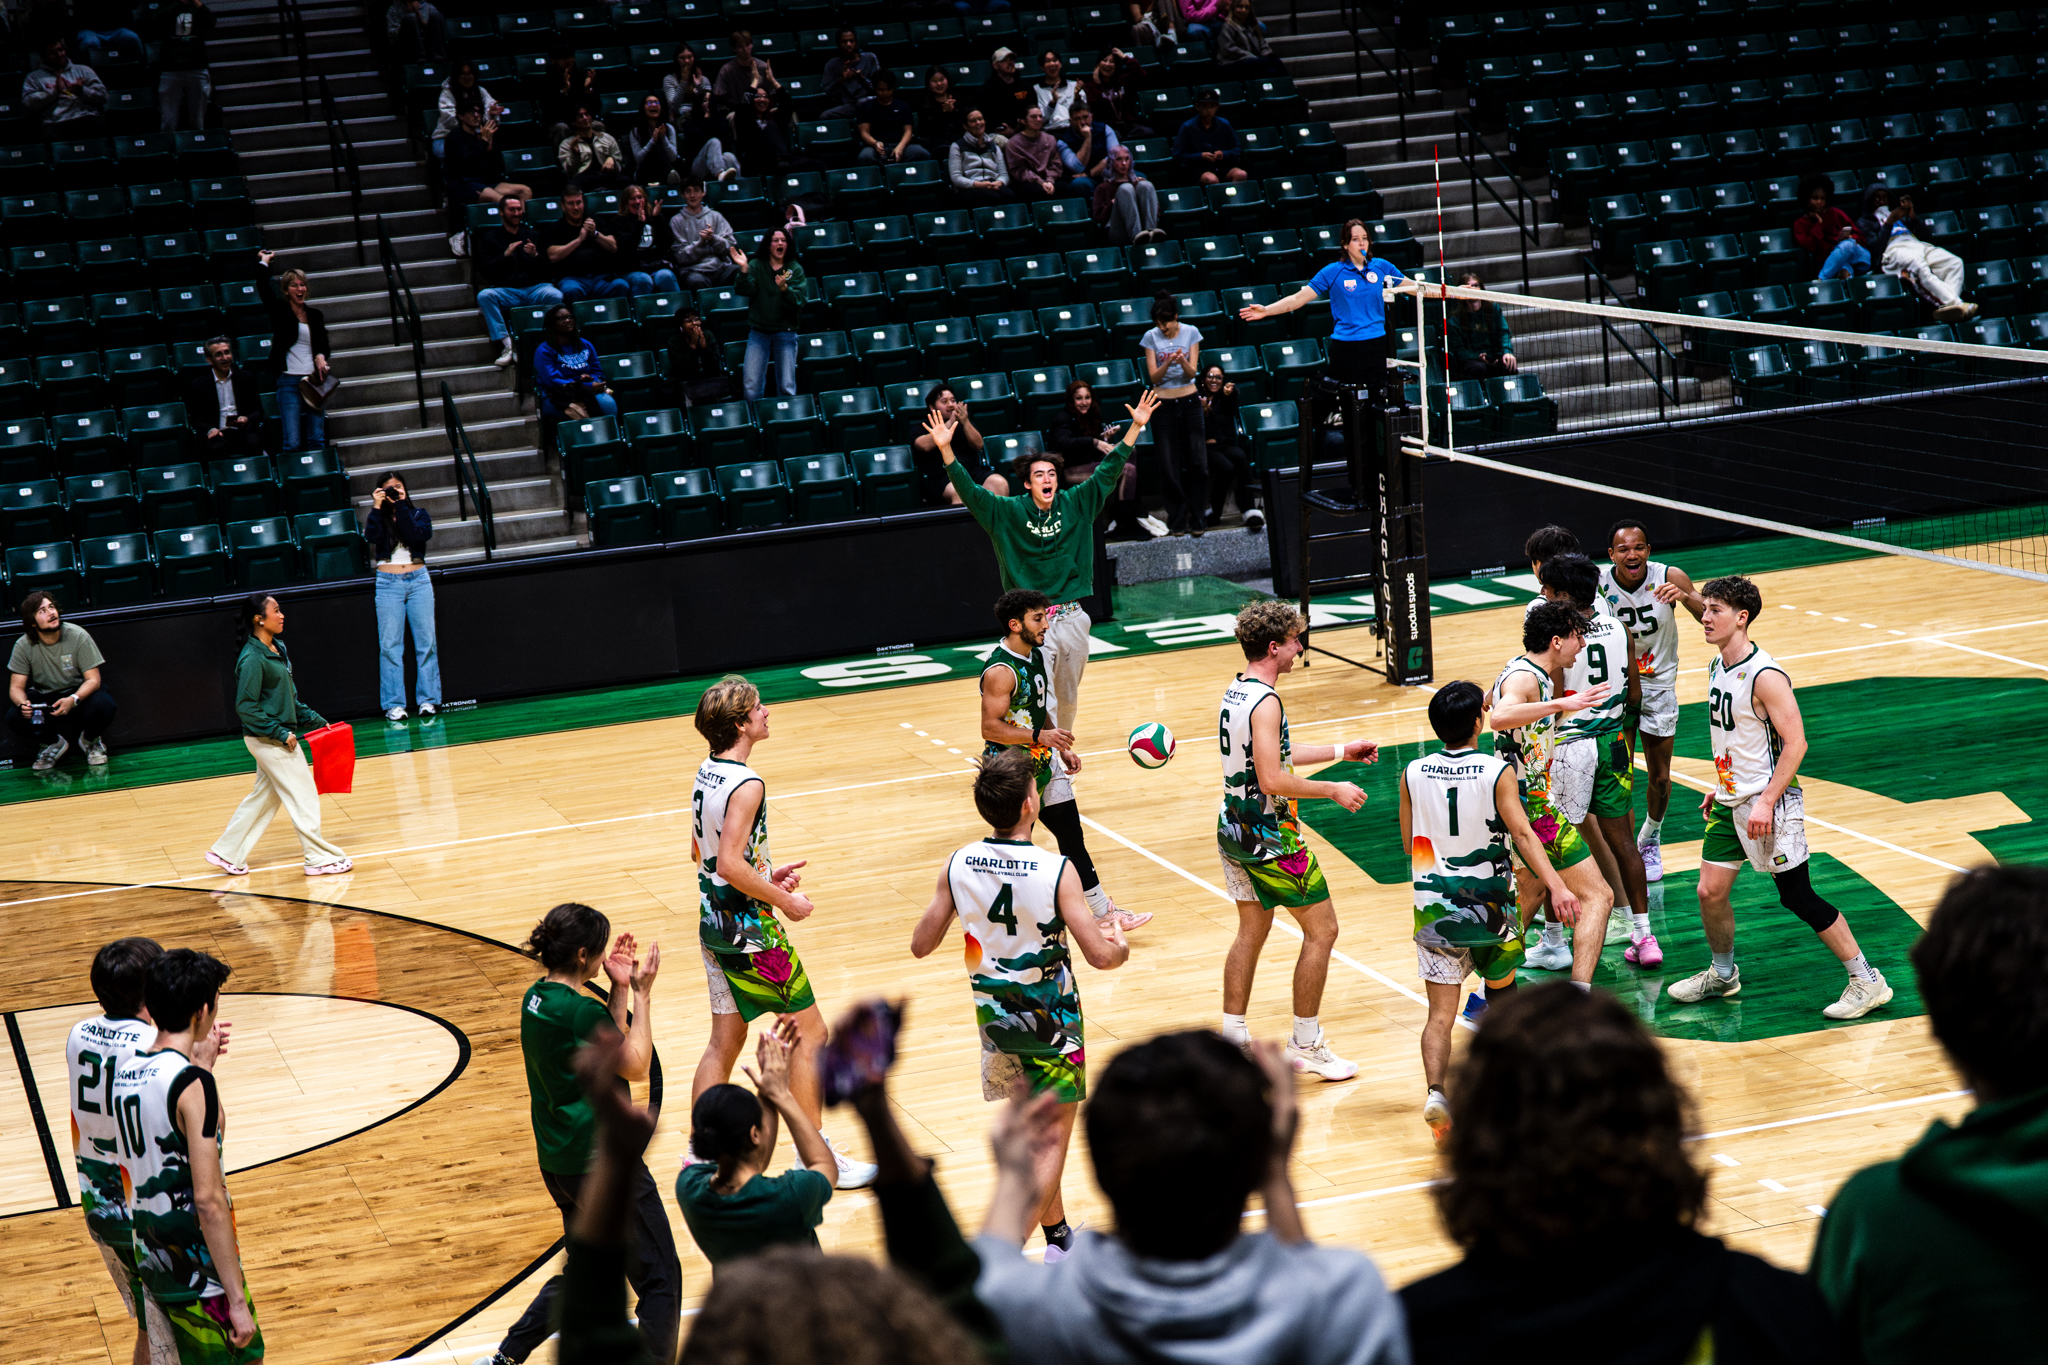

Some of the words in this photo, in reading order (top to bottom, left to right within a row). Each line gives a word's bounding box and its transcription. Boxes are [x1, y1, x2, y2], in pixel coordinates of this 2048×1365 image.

[1378, 473, 1394, 666] CHARLOTTE
[1406, 572, 1417, 603] sports
[1407, 603, 1419, 640] imports
[1617, 604, 1659, 639] 25
[876, 643, 914, 652] DAKTRONICS
[1587, 643, 1608, 686] 9
[441, 699, 477, 708] AKTRONICS
[1034, 673, 1046, 709] 9
[1710, 687, 1736, 731] 20
[1220, 708, 1231, 757] 6
[1421, 764, 1485, 775] CHARLOTTE
[693, 789, 704, 838] 3
[1446, 787, 1459, 836] 1
[965, 856, 1038, 871] CHARLOTTE
[987, 882, 1018, 936] 4
[78, 1049, 117, 1117] 21
[114, 1094, 146, 1159] 10
